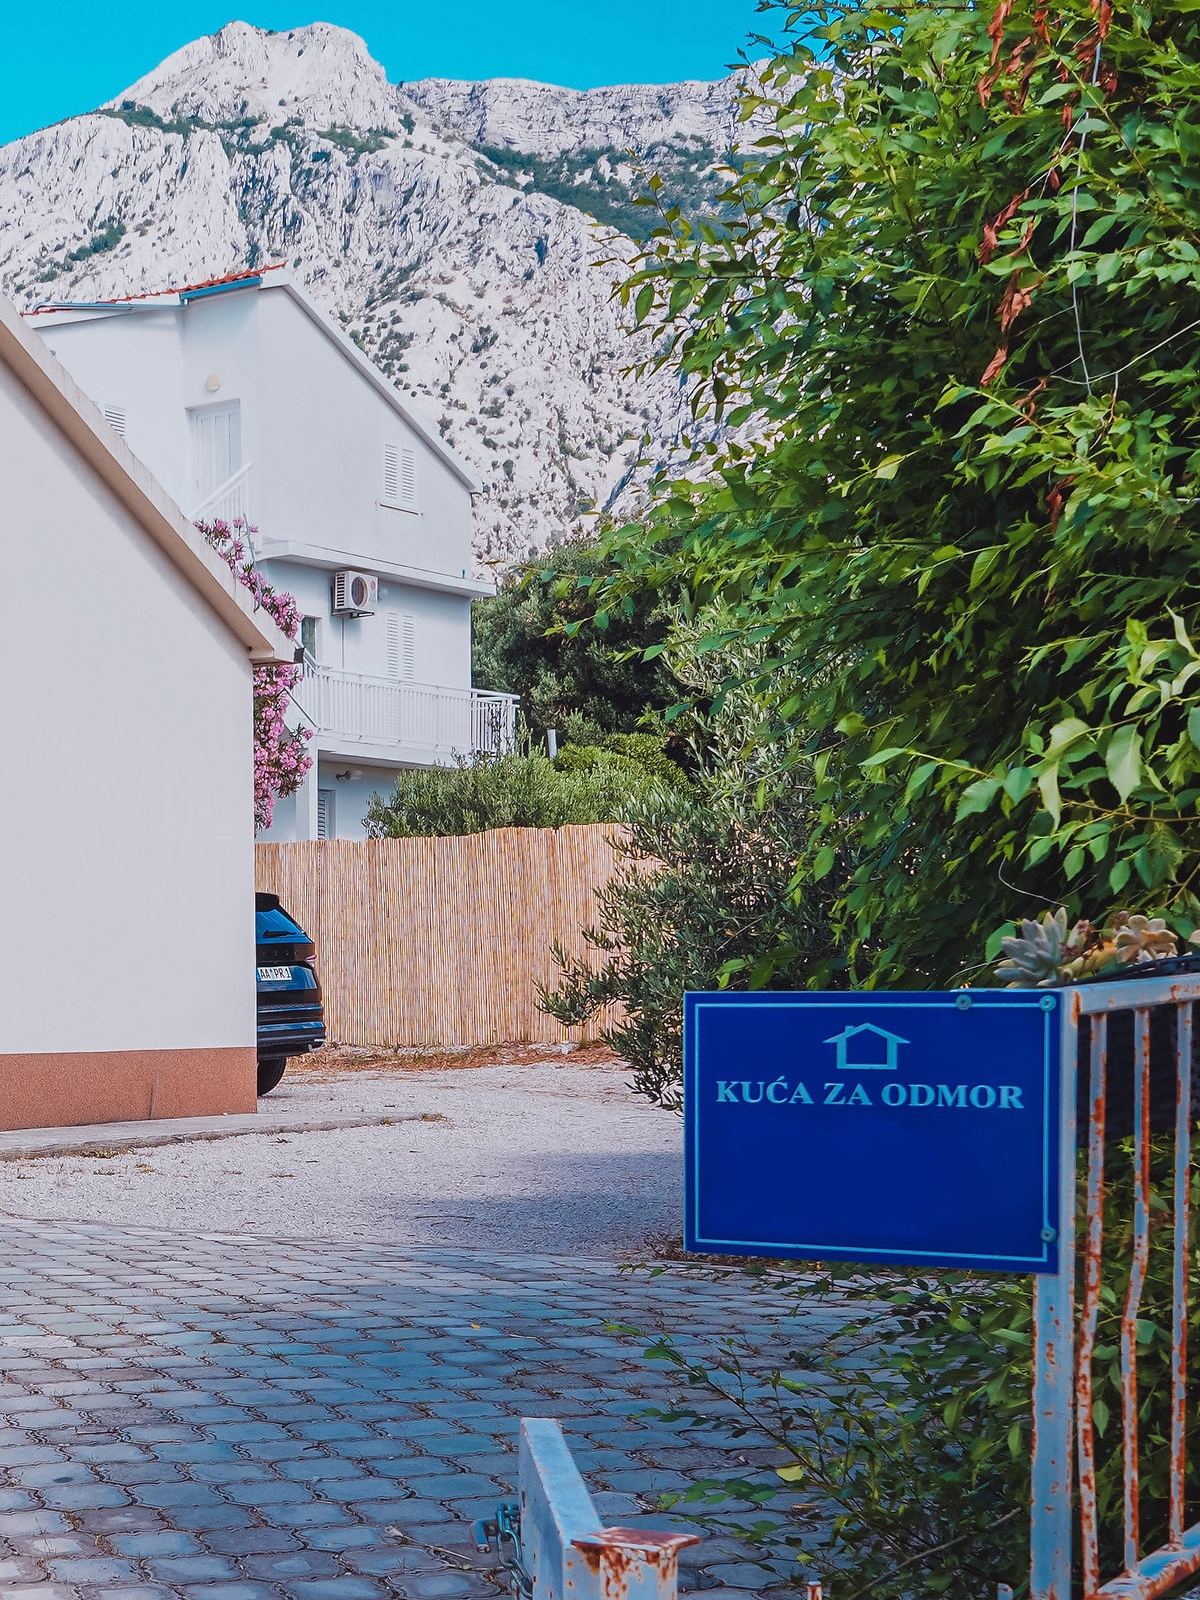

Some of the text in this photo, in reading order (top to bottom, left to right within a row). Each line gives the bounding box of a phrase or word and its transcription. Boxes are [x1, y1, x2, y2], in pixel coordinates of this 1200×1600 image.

[715, 1075, 1024, 1109] KUĆA ZA ODMOR
